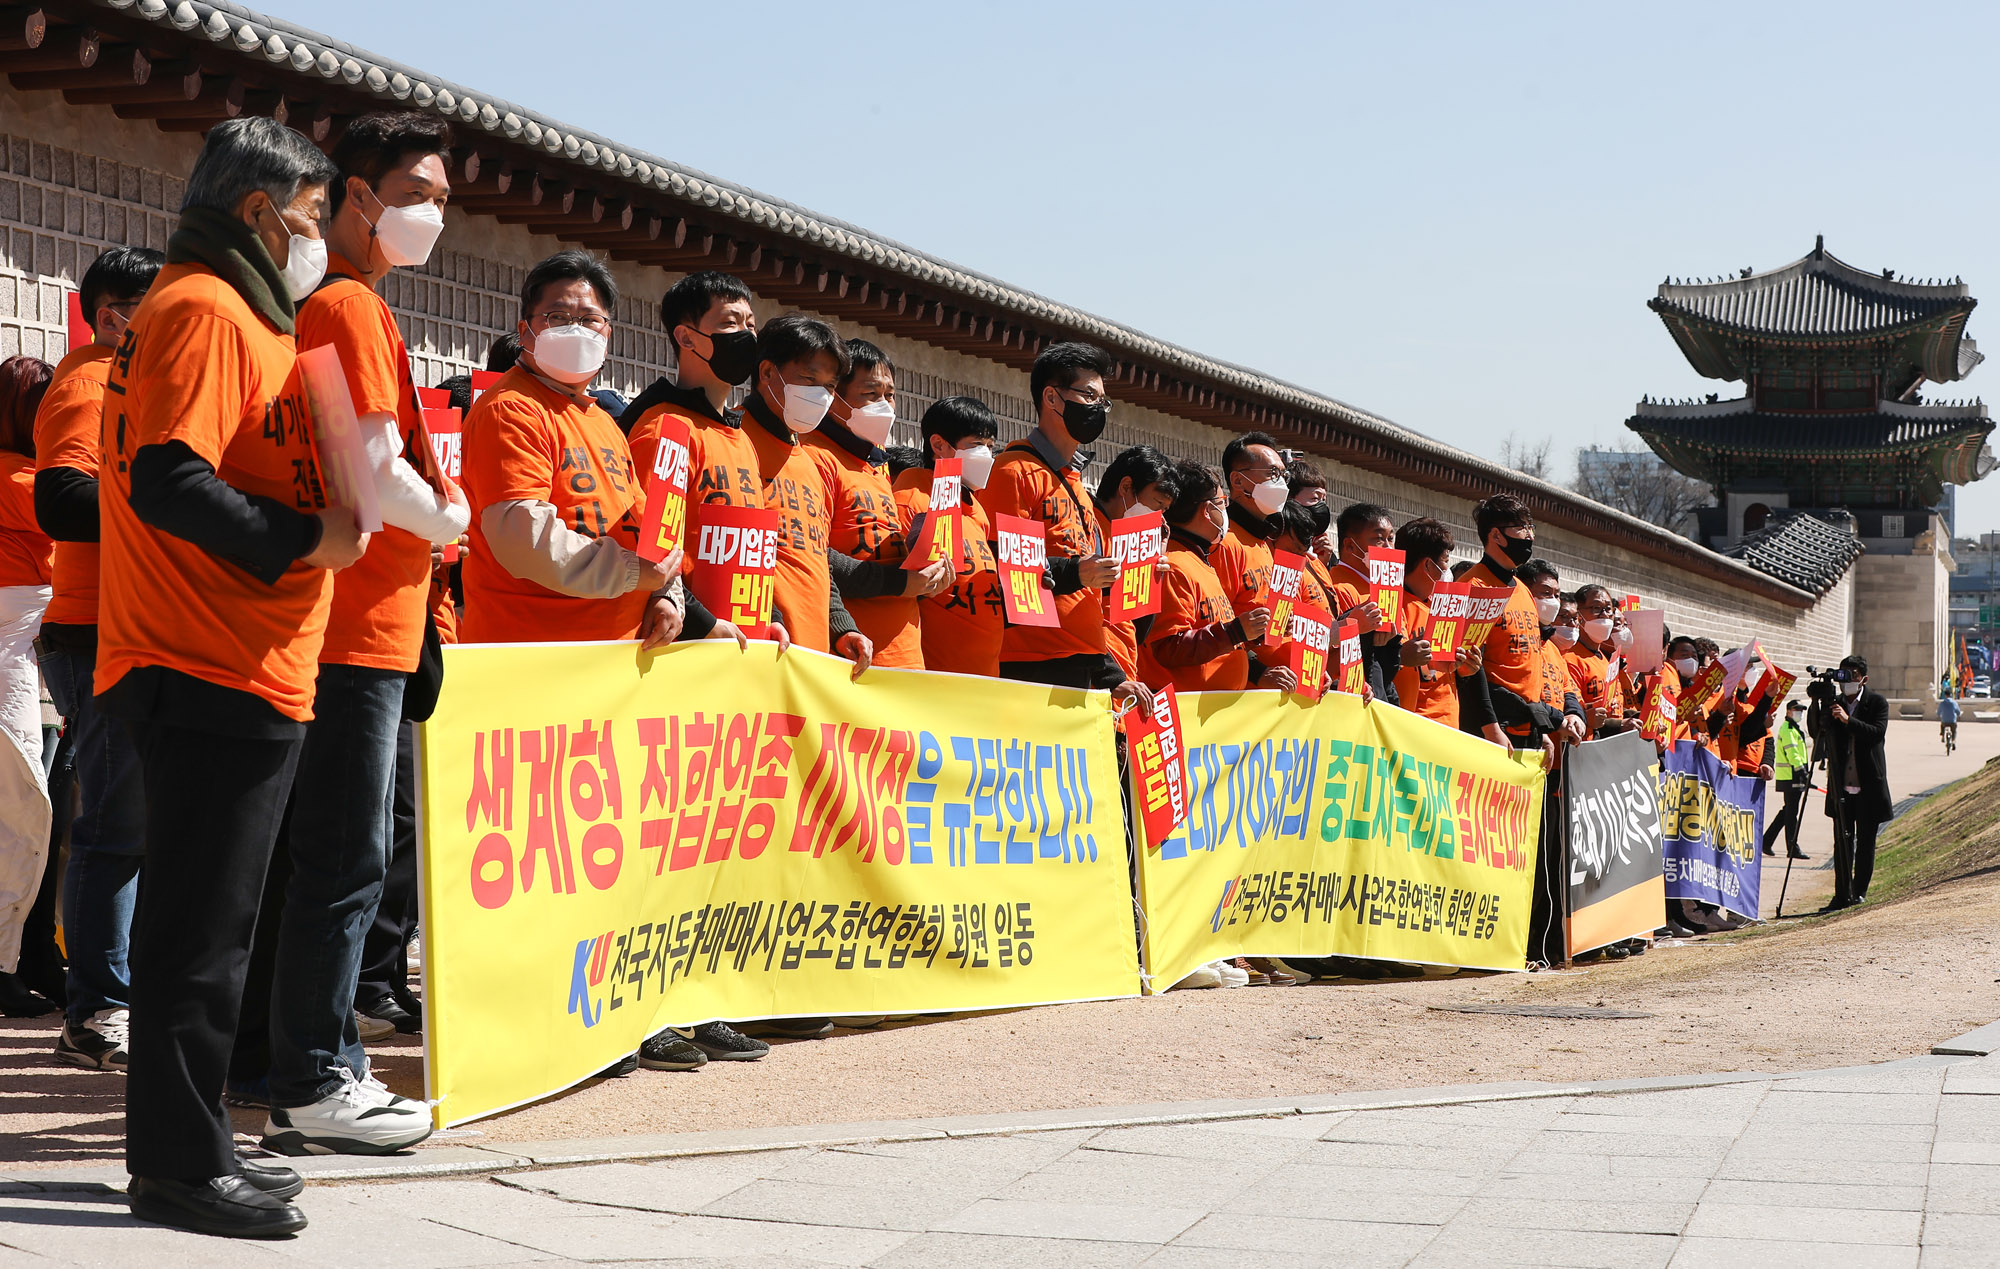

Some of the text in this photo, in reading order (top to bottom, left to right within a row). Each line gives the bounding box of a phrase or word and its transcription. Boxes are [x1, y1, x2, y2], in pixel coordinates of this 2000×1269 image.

[697, 525, 764, 567] 대기업
[1010, 570, 1044, 615] 반대
[1122, 563, 1152, 610] 반대
[1378, 589, 1398, 624] 반대
[1431, 620, 1457, 653] 반대
[1302, 649, 1323, 691] 반대
[1135, 731, 1169, 814] 반대
[466, 718, 624, 910] 생계형
[636, 711, 807, 876] 적합업종
[943, 736, 1098, 868] 규탄한다!!
[1455, 771, 1532, 871] 결사반대!!
[946, 902, 988, 969] 회원
[994, 902, 1034, 968] 일동
[1445, 888, 1476, 937] 회원
[1474, 893, 1500, 940] 일동
